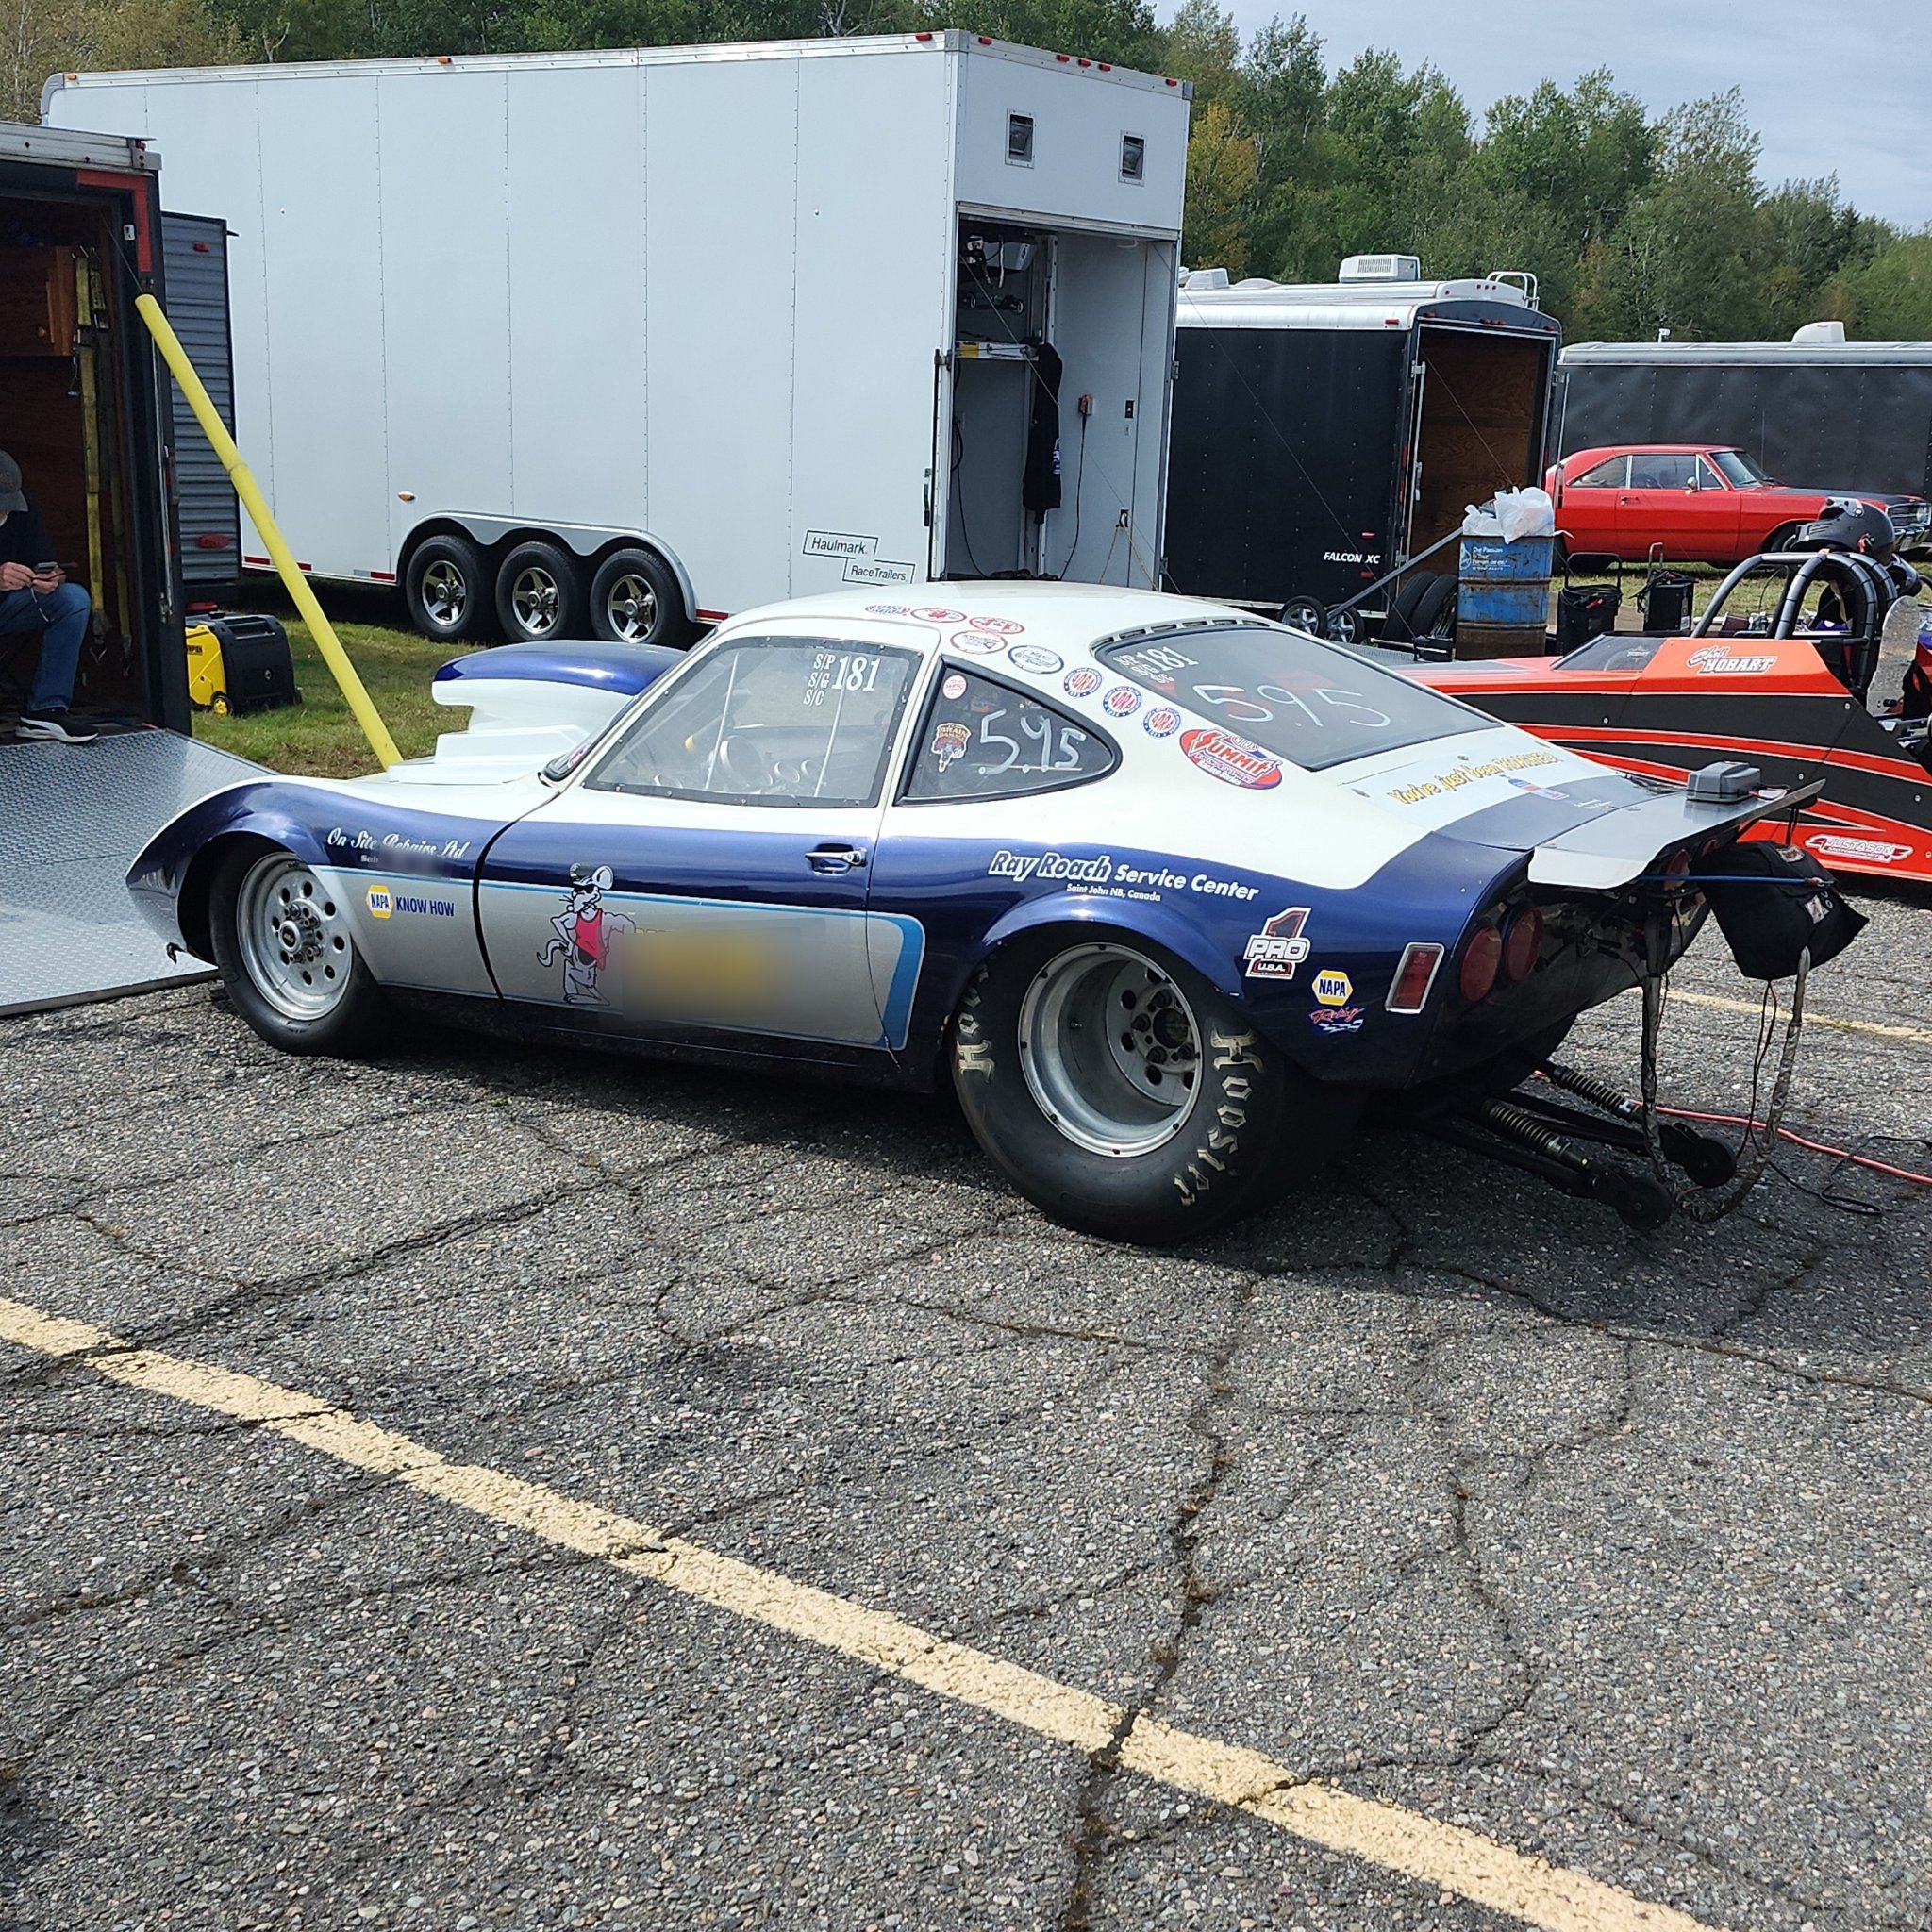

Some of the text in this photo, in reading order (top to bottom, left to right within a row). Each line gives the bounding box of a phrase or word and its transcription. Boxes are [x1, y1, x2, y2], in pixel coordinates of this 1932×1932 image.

[811, 537, 867, 555] Haulmark
[1323, 551, 1381, 564] FALCON XC
[813, 653, 836, 671] S/P
[1135, 646, 1199, 671] 181
[1699, 657, 1775, 674] HOBART
[808, 672, 830, 689] S/G
[831, 656, 881, 691] 181
[803, 689, 825, 707] S/C
[1435, 767, 1473, 792] just
[327, 827, 347, 847] On
[350, 830, 378, 850] Site
[1826, 837, 1896, 855] JUSTASON
[989, 850, 1260, 902] Ray Roach Service Center
[371, 893, 391, 909] NAPA
[1066, 882, 1161, 903] Saint John NB, Canada
[395, 896, 455, 917] KNOW HOW
[1246, 937, 1308, 960] PRO
[1318, 978, 1347, 998] NAPA
